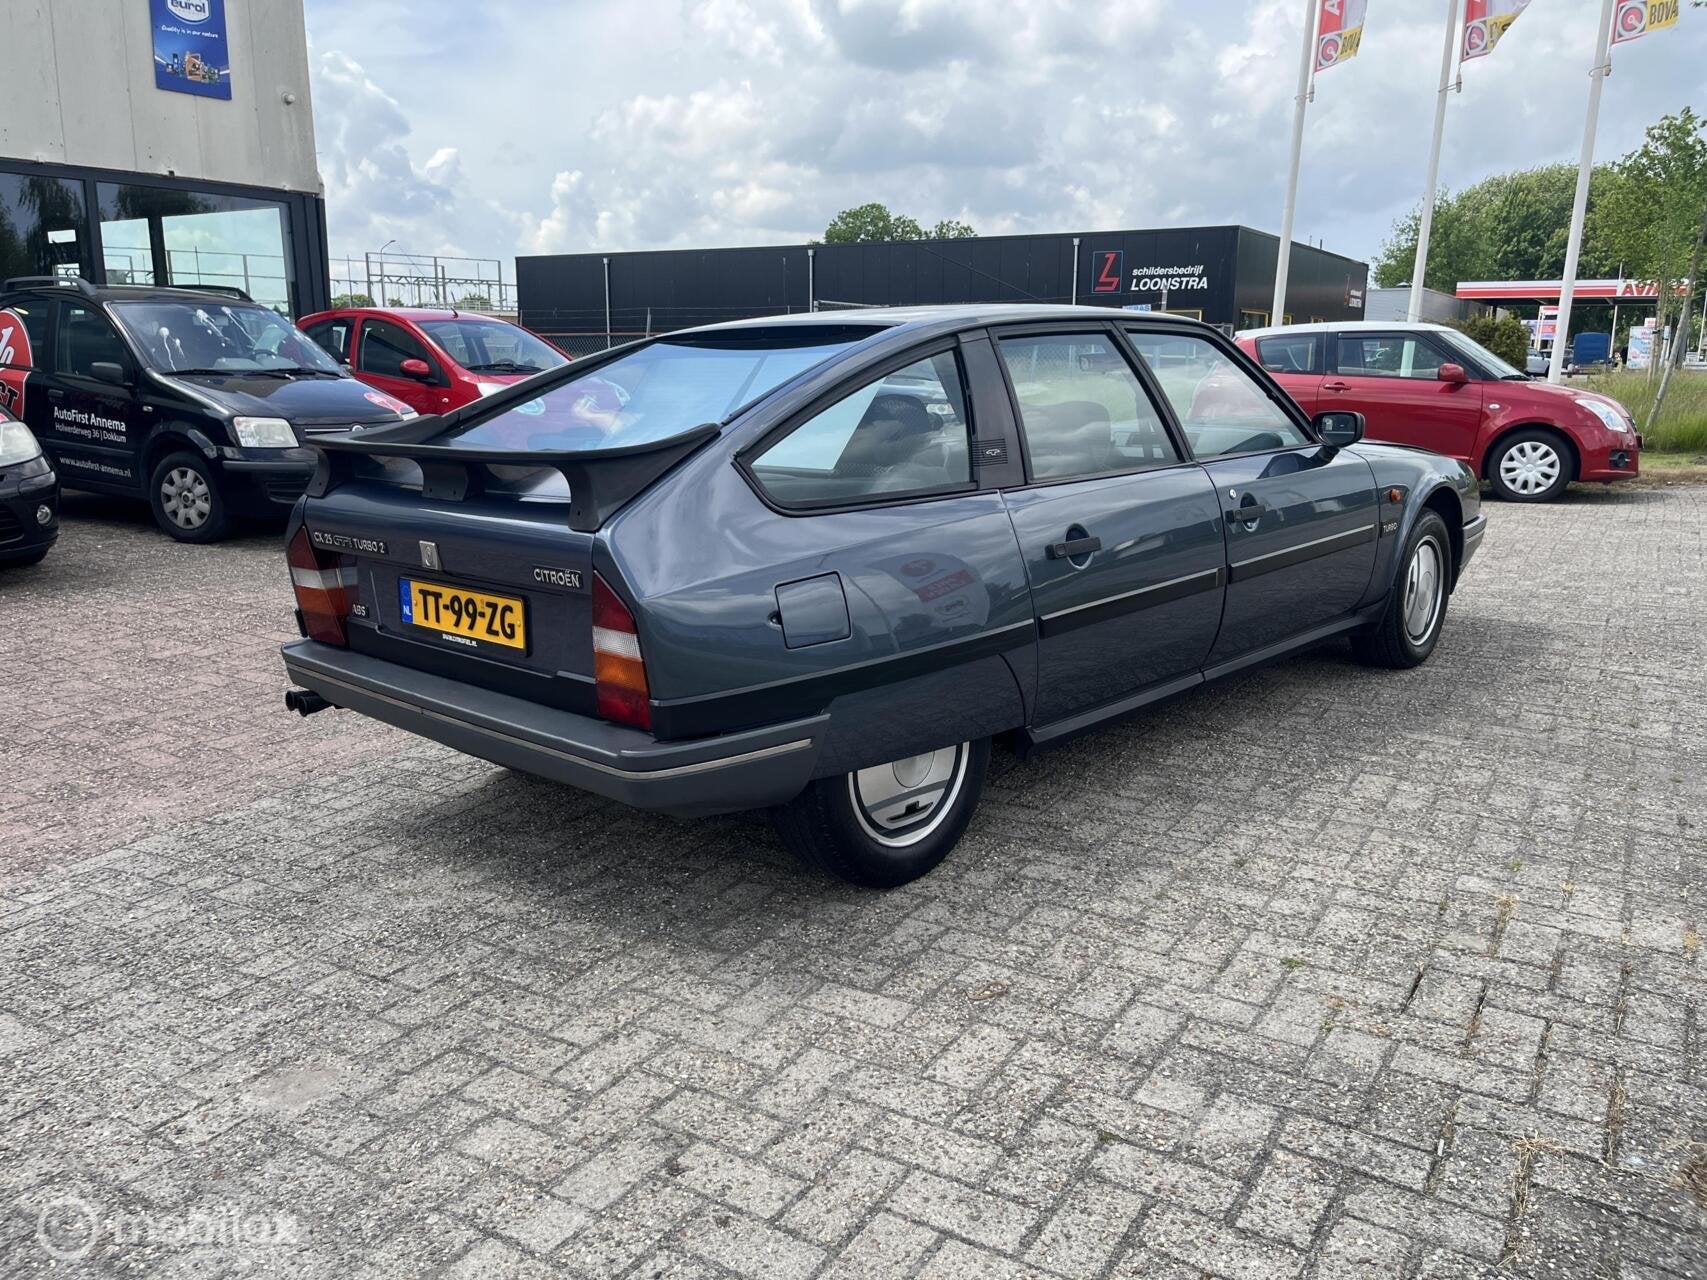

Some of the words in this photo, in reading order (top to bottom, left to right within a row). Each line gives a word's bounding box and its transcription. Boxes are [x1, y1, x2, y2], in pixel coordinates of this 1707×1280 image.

[1132, 265, 1203, 276] schildersbedrijf
[1130, 277, 1208, 291] LOONSTRA
[54, 406, 89, 425] AutoFirst
[90, 413, 126, 432] Annema
[55, 423, 91, 439] Holwerderweg
[92, 429, 100, 438] 36
[103, 431, 127, 443] Dokkum
[59, 457, 132, 477] www.autofirst-annema.nl
[313, 532, 324, 543] CX
[324, 533, 333, 544] 25
[352, 538, 378, 552] TURBO
[378, 542, 385, 553] 2
[533, 567, 580, 588] CITROËN
[403, 604, 412, 616] NL
[418, 588, 516, 641] TT-99-ZG
